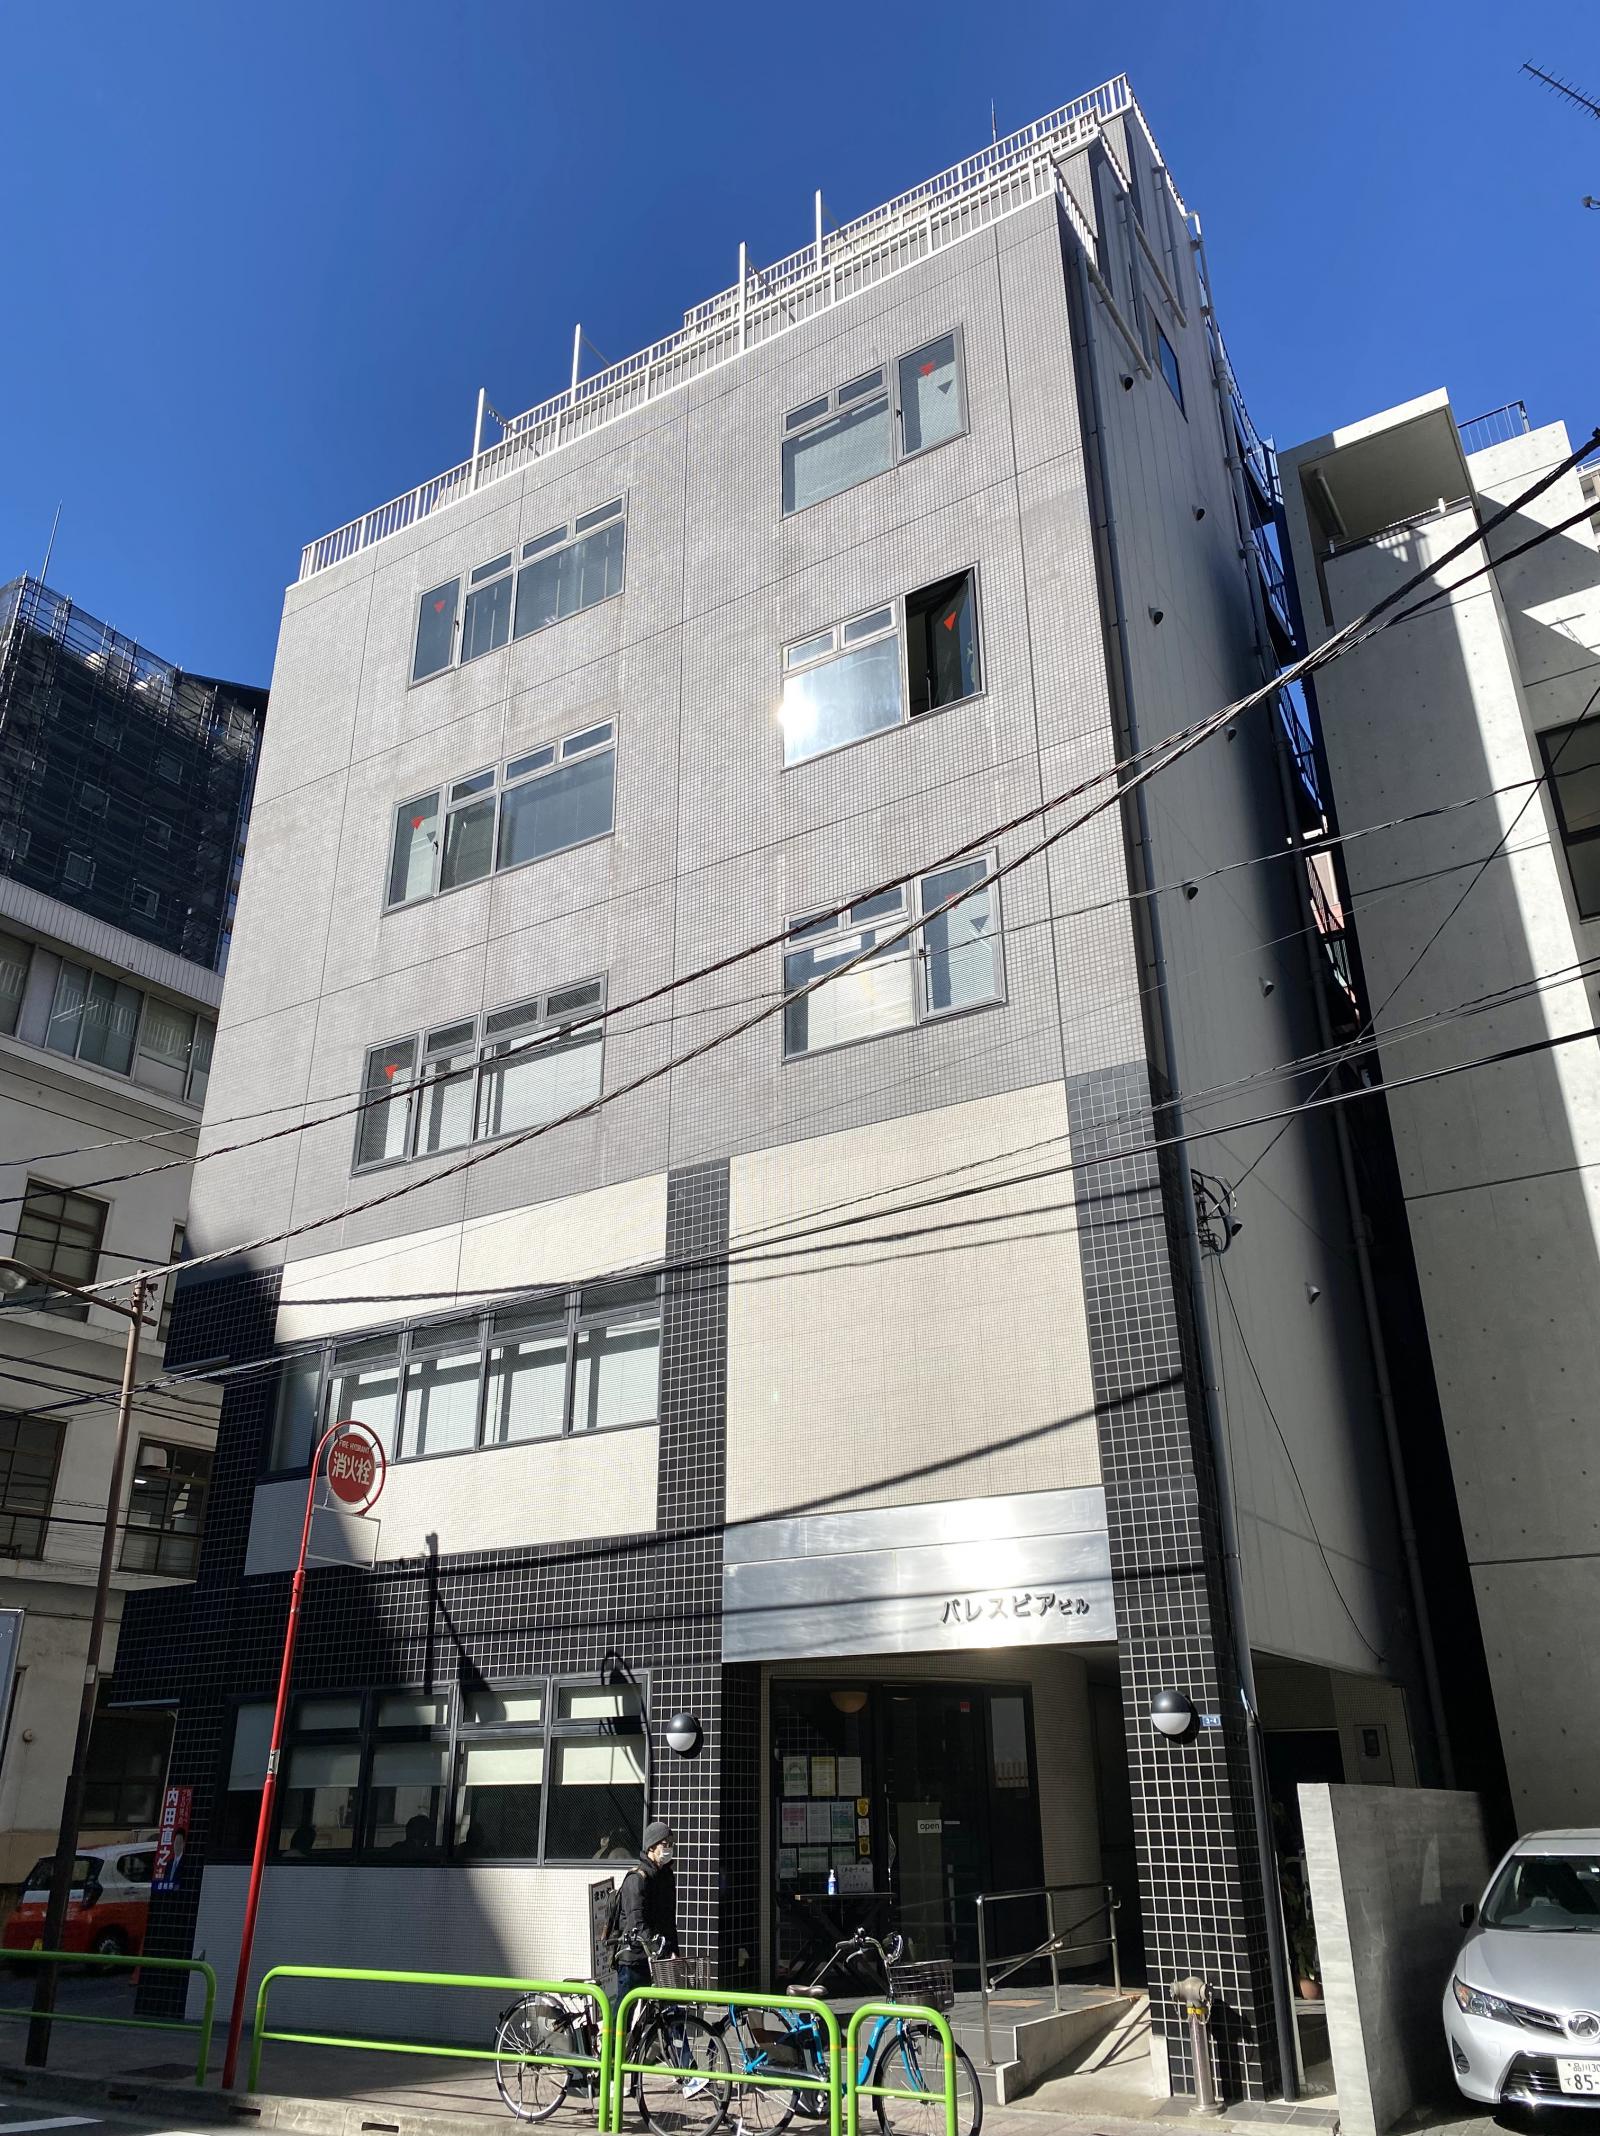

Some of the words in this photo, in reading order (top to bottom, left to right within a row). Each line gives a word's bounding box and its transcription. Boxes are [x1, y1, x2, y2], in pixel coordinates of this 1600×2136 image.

[338, 1439, 350, 1449] FIRE
[350, 1442, 370, 1454] HYDRANT
[331, 1450, 372, 1486] 消火栓
[156, 1787, 179, 1866] 内田直之
[920, 1823, 939, 1831] open
